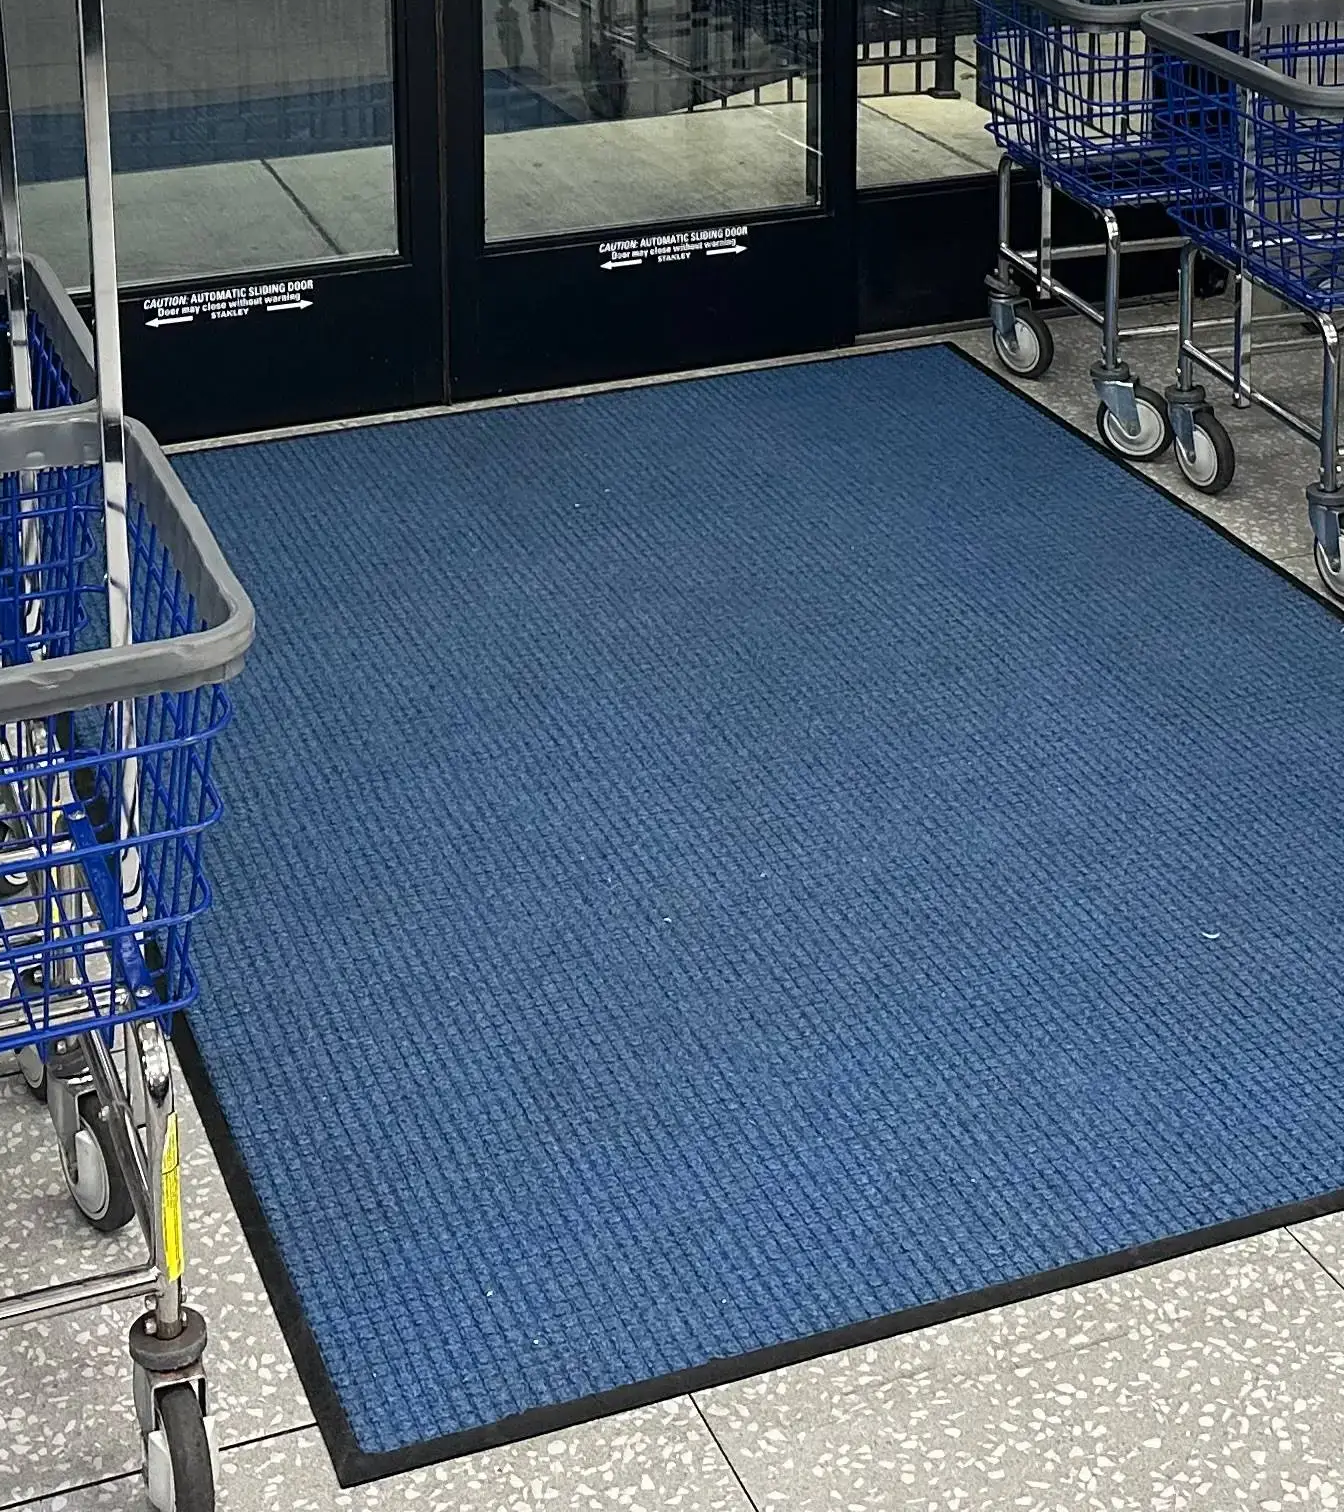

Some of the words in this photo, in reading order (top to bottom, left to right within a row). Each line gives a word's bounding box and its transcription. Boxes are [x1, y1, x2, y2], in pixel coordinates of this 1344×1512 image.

[599, 241, 639, 253] CAUTION:
[640, 233, 689, 248] AUTOMATIC
[691, 228, 723, 242] SLIDING
[725, 226, 748, 237] DOOR
[143, 295, 189, 310] CAUTION:
[190, 288, 246, 304] AUTOMATIC
[248, 282, 285, 296] SLIDING
[287, 279, 314, 291] DOOR
[158, 306, 179, 317] Door
[181, 305, 200, 315] may
[202, 301, 227, 311] close
[229, 297, 263, 308] without
[264, 292, 301, 304] warning
[211, 308, 249, 320] STANLEY
